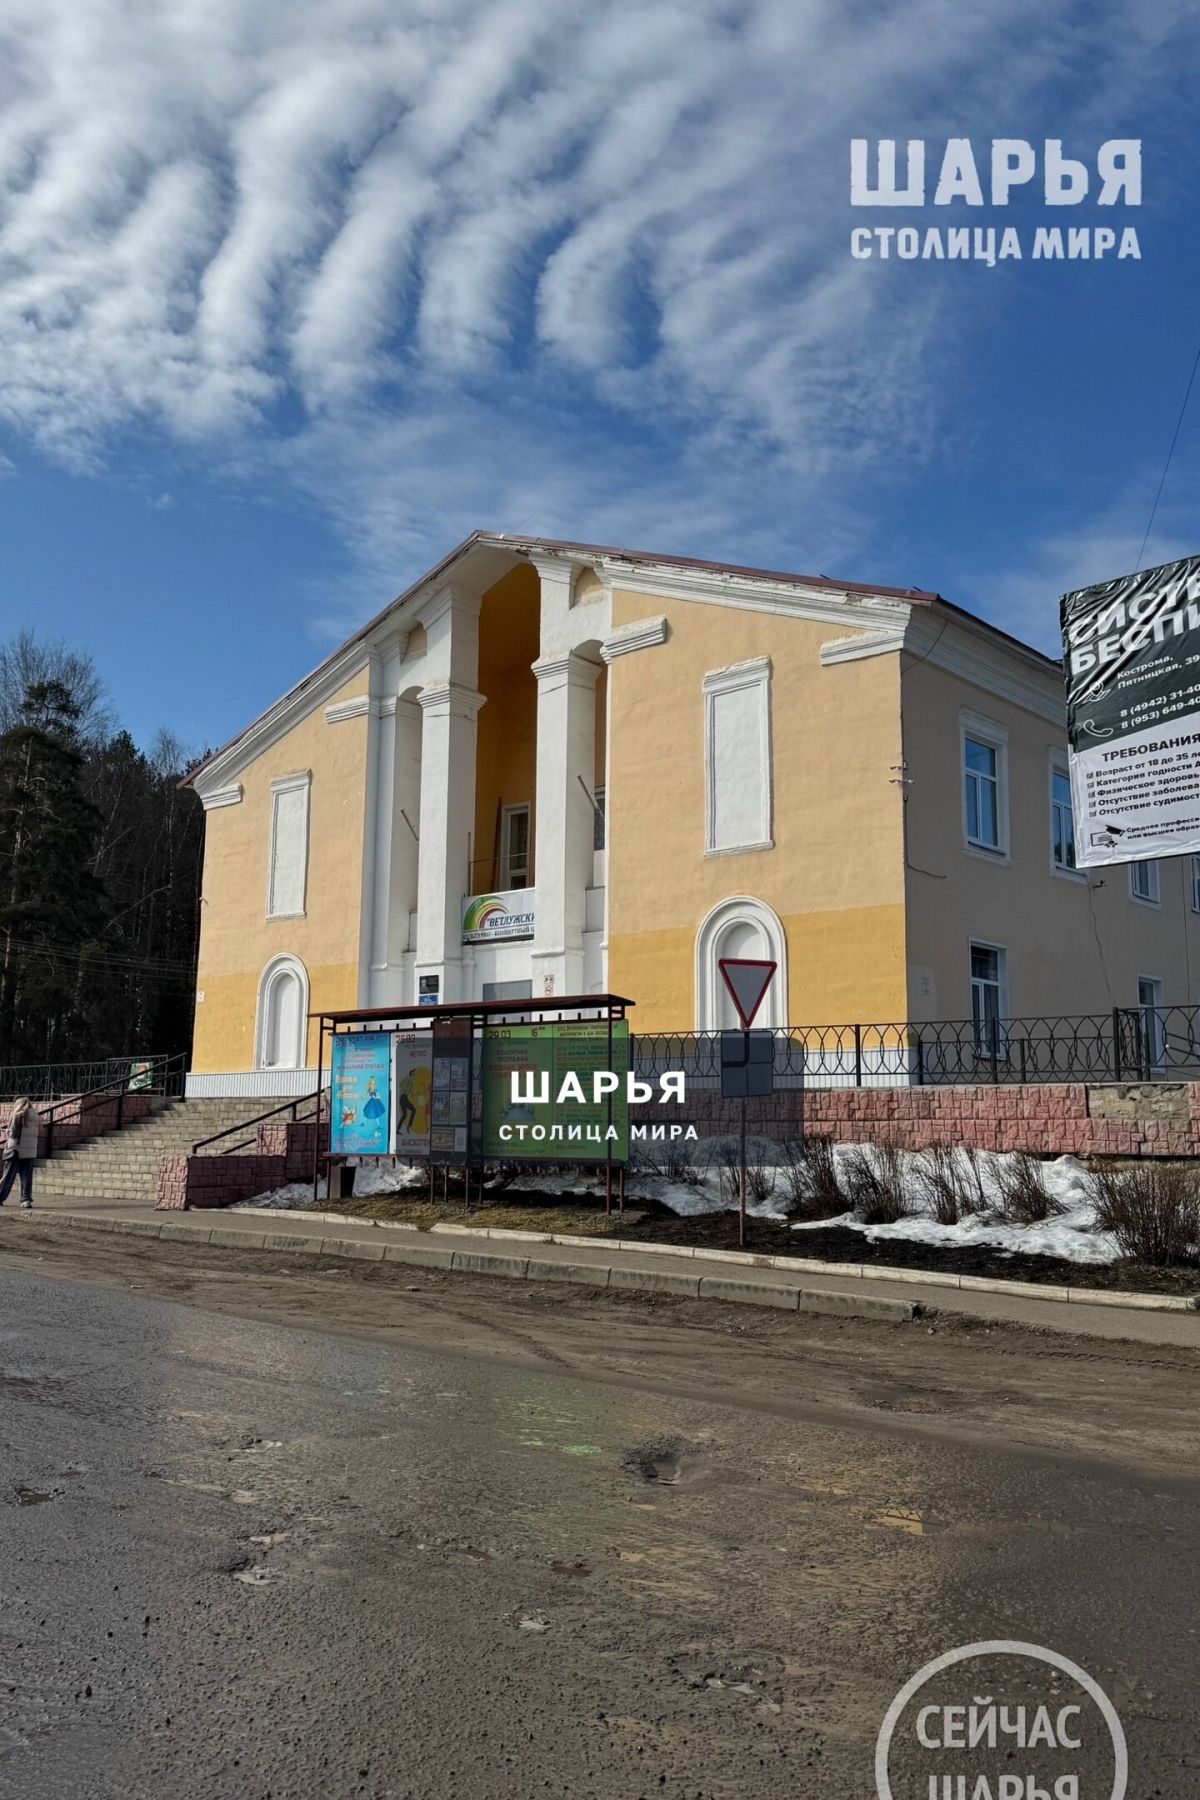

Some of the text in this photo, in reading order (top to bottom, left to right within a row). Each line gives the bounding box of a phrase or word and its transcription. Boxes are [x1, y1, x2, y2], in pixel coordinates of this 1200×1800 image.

[1117, 655, 1174, 679] Кострома,
[1118, 661, 1182, 689] Пятницкая,
[1120, 708, 1128, 717] 8
[1130, 695, 1167, 715] (4942)
[1121, 720, 1129, 729] 8
[1131, 707, 1160, 728] (953)
[1102, 732, 1200, 762] ТРЕБОВАНИЯ
[1095, 764, 1133, 778] Возраст
[1147, 758, 1159, 766] 18
[1161, 757, 1174, 766] до
[1175, 752, 1189, 761] 35
[1096, 772, 1145, 787] Категория
[1147, 763, 1192, 777] годности
[1097, 780, 1155, 796] Физическое
[1098, 791, 1150, 807] Отсутствие
[1099, 801, 1151, 816] Отсутствие
